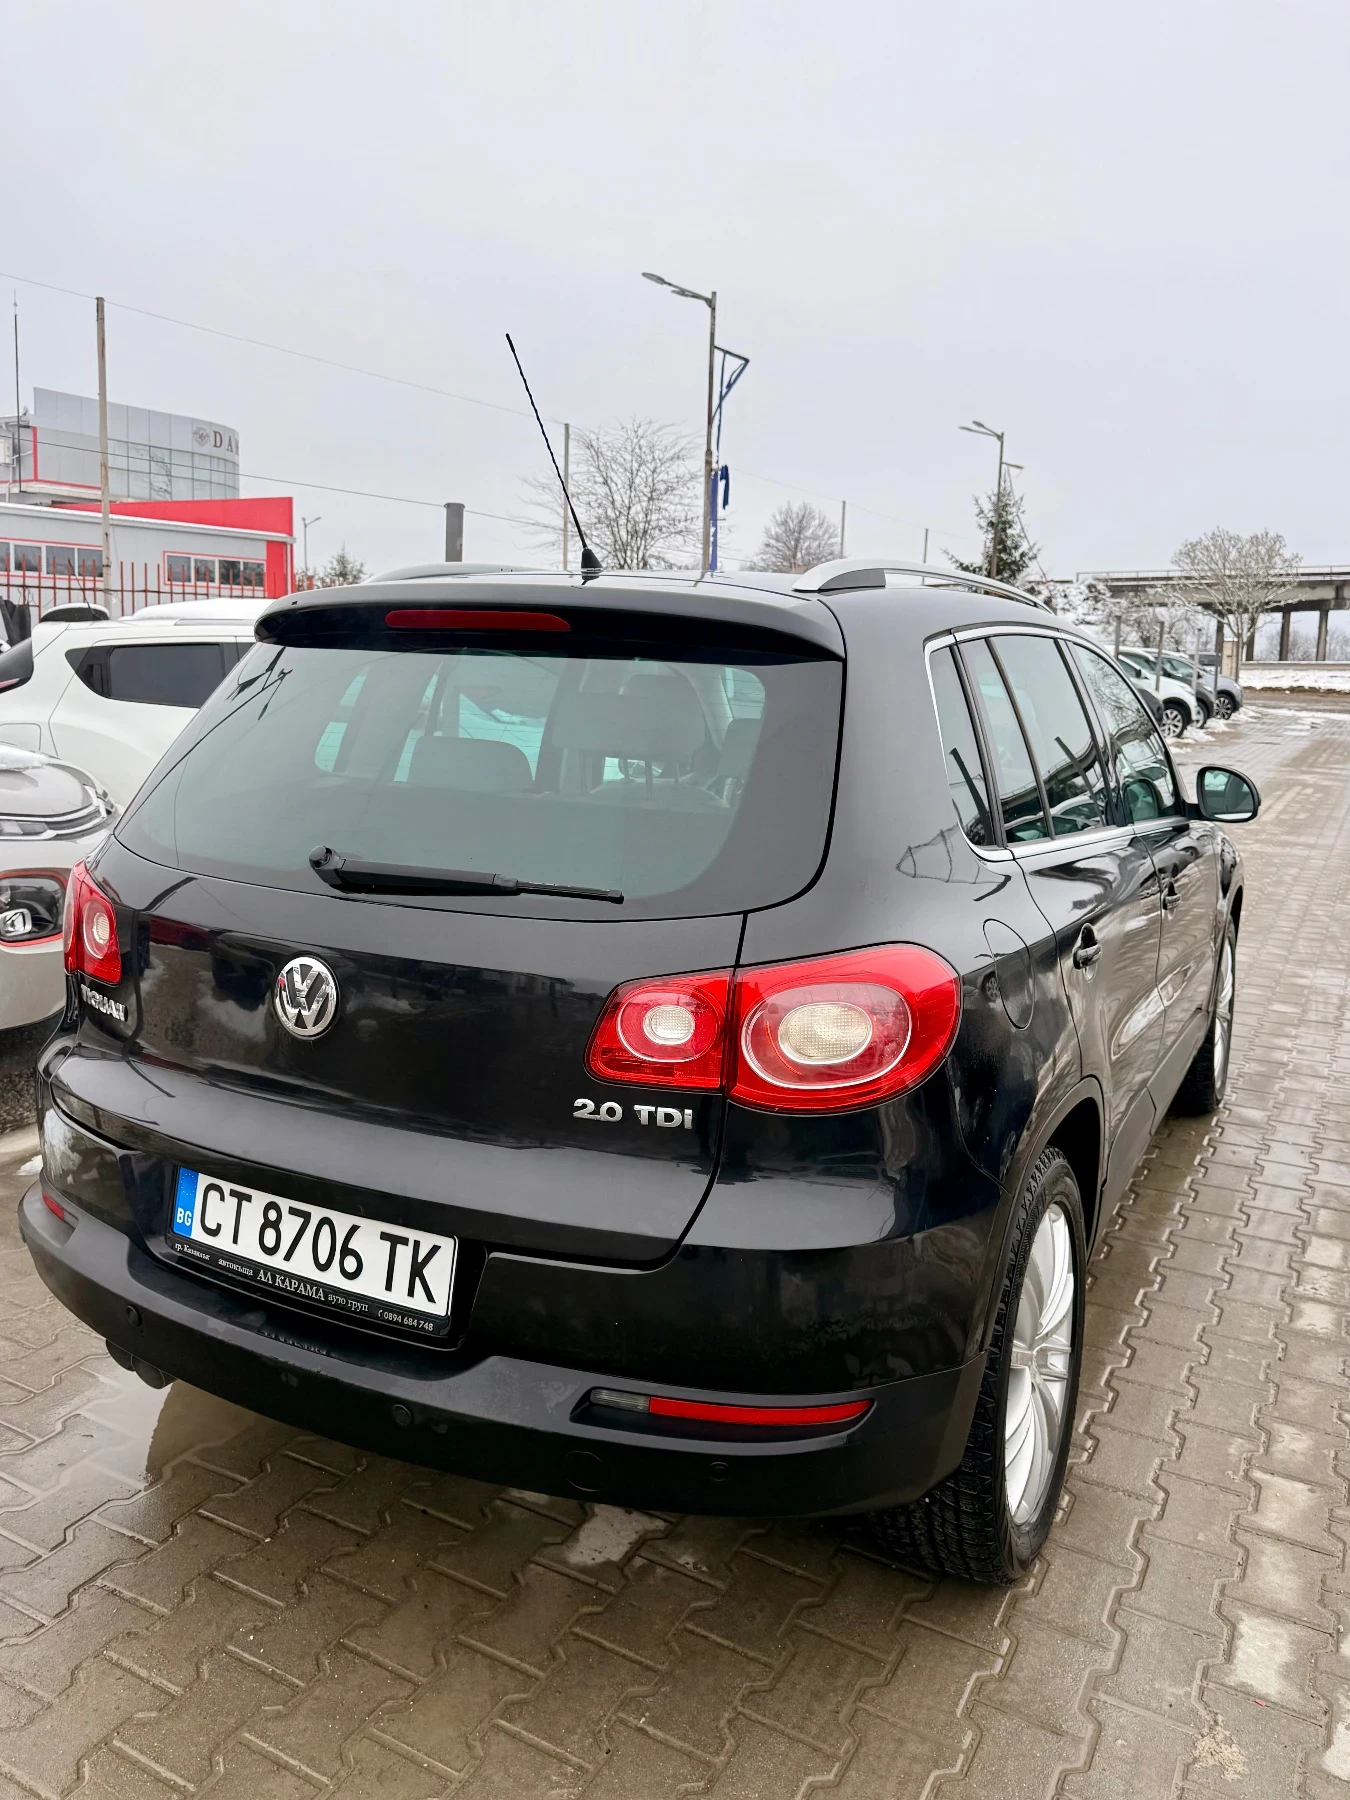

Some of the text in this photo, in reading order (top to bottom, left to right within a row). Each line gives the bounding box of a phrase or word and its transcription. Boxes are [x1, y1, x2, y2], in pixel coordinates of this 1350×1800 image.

[276, 957, 336, 1036] VW
[633, 1104, 693, 1130] TDI
[176, 1207, 192, 1227] BG
[258, 1200, 364, 1281] 8706
[256, 1269, 273, 1284] АЛ
[274, 1273, 325, 1301] КАРАМА
[328, 1293, 346, 1305] ауто
[348, 1299, 369, 1312] груп
[383, 1311, 402, 1323] 0894
[403, 1317, 418, 1328] 684
[418, 1320, 434, 1331] 748
